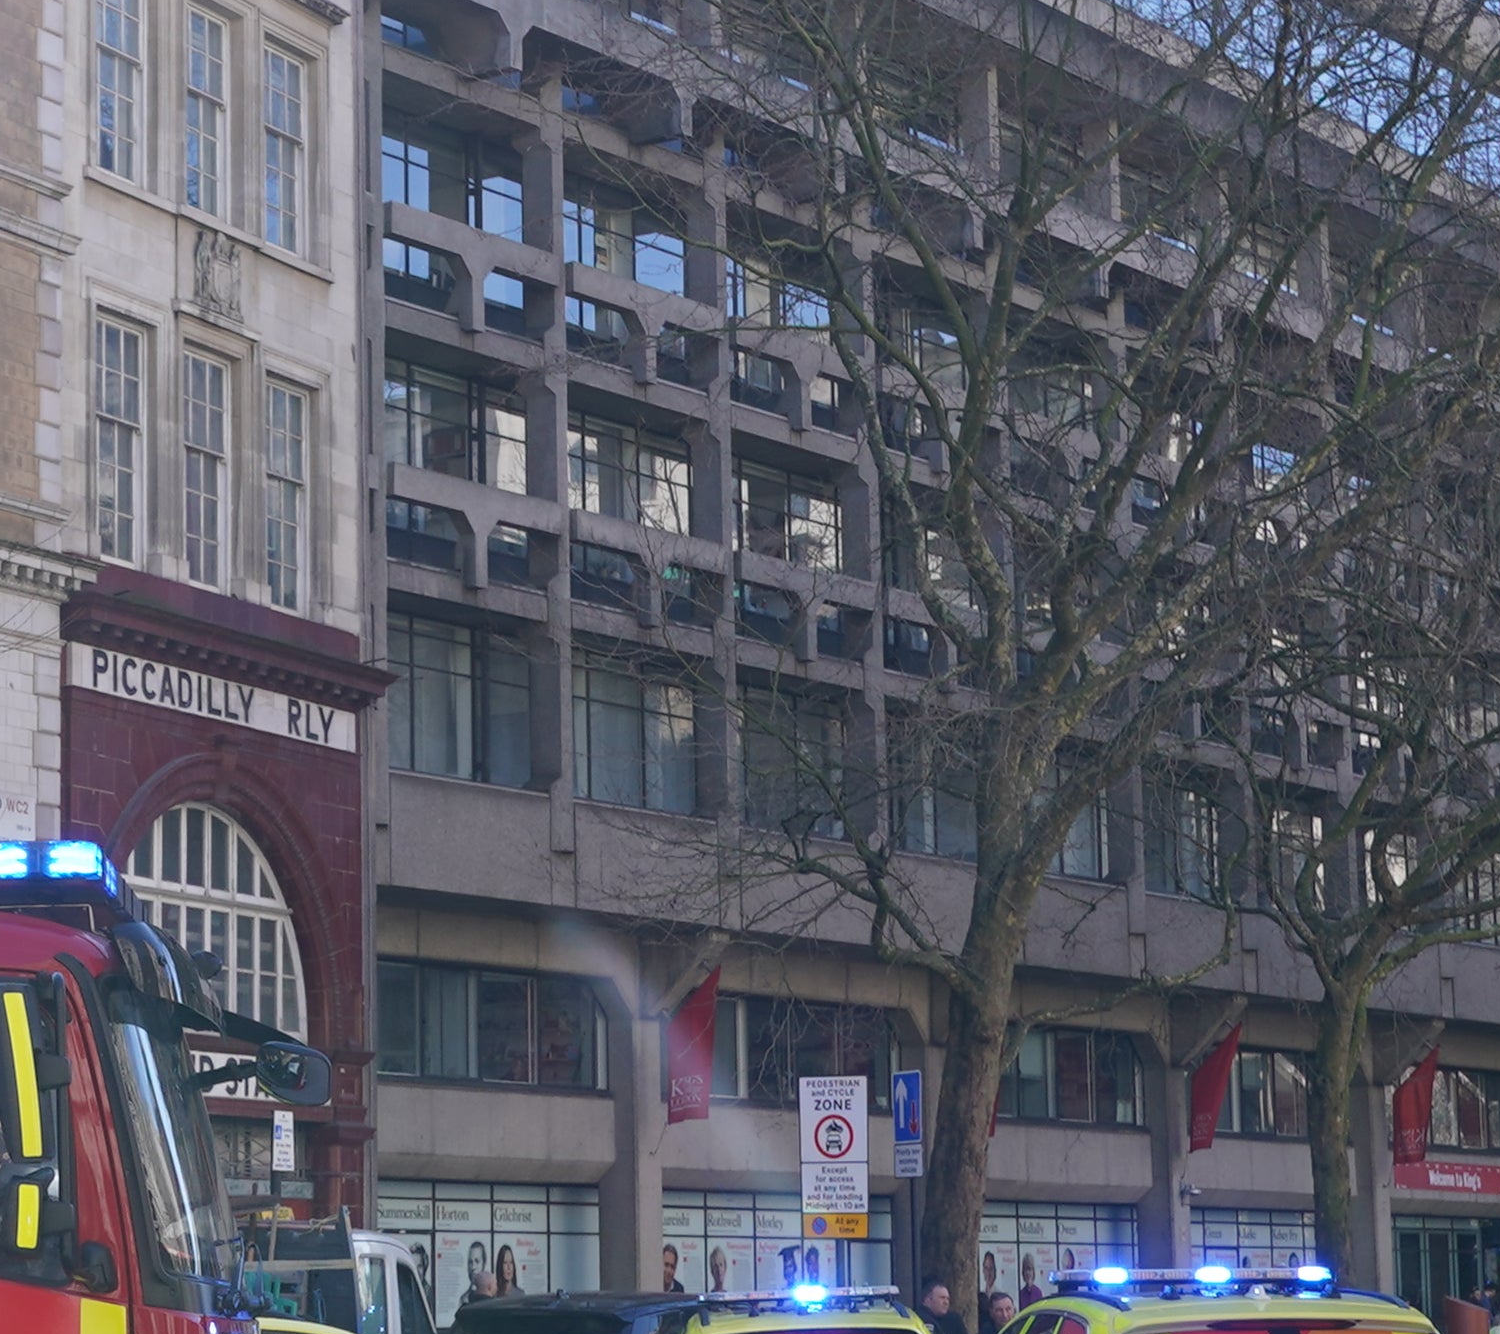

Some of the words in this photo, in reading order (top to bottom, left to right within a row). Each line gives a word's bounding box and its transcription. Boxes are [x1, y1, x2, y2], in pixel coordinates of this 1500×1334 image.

[92, 648, 255, 724] PICCADILLY
[287, 698, 335, 744] RLY
[6, 796, 30, 815] WC2
[805, 1079, 860, 1088] PEDESTRIAN
[811, 1088, 825, 1097] and
[826, 1088, 855, 1097] CYCLE
[813, 1099, 852, 1111] ZONE
[821, 1166, 848, 1175] Except
[815, 1174, 828, 1182] for
[814, 1184, 822, 1192] at
[824, 1185, 837, 1193] any
[839, 1184, 856, 1192] time
[807, 1192, 821, 1200] and
[822, 1192, 834, 1200] for
[835, 1193, 863, 1202] loading
[805, 1201, 839, 1211] Midnight
[376, 1203, 431, 1220] Summerskill
[435, 1205, 470, 1221] Horton
[494, 1207, 532, 1223] Gilchrist
[707, 1212, 742, 1228] Rothwell
[755, 1215, 784, 1231] Morley
[836, 1217, 845, 1225] At
[846, 1218, 859, 1227] any
[838, 1226, 856, 1234] time
